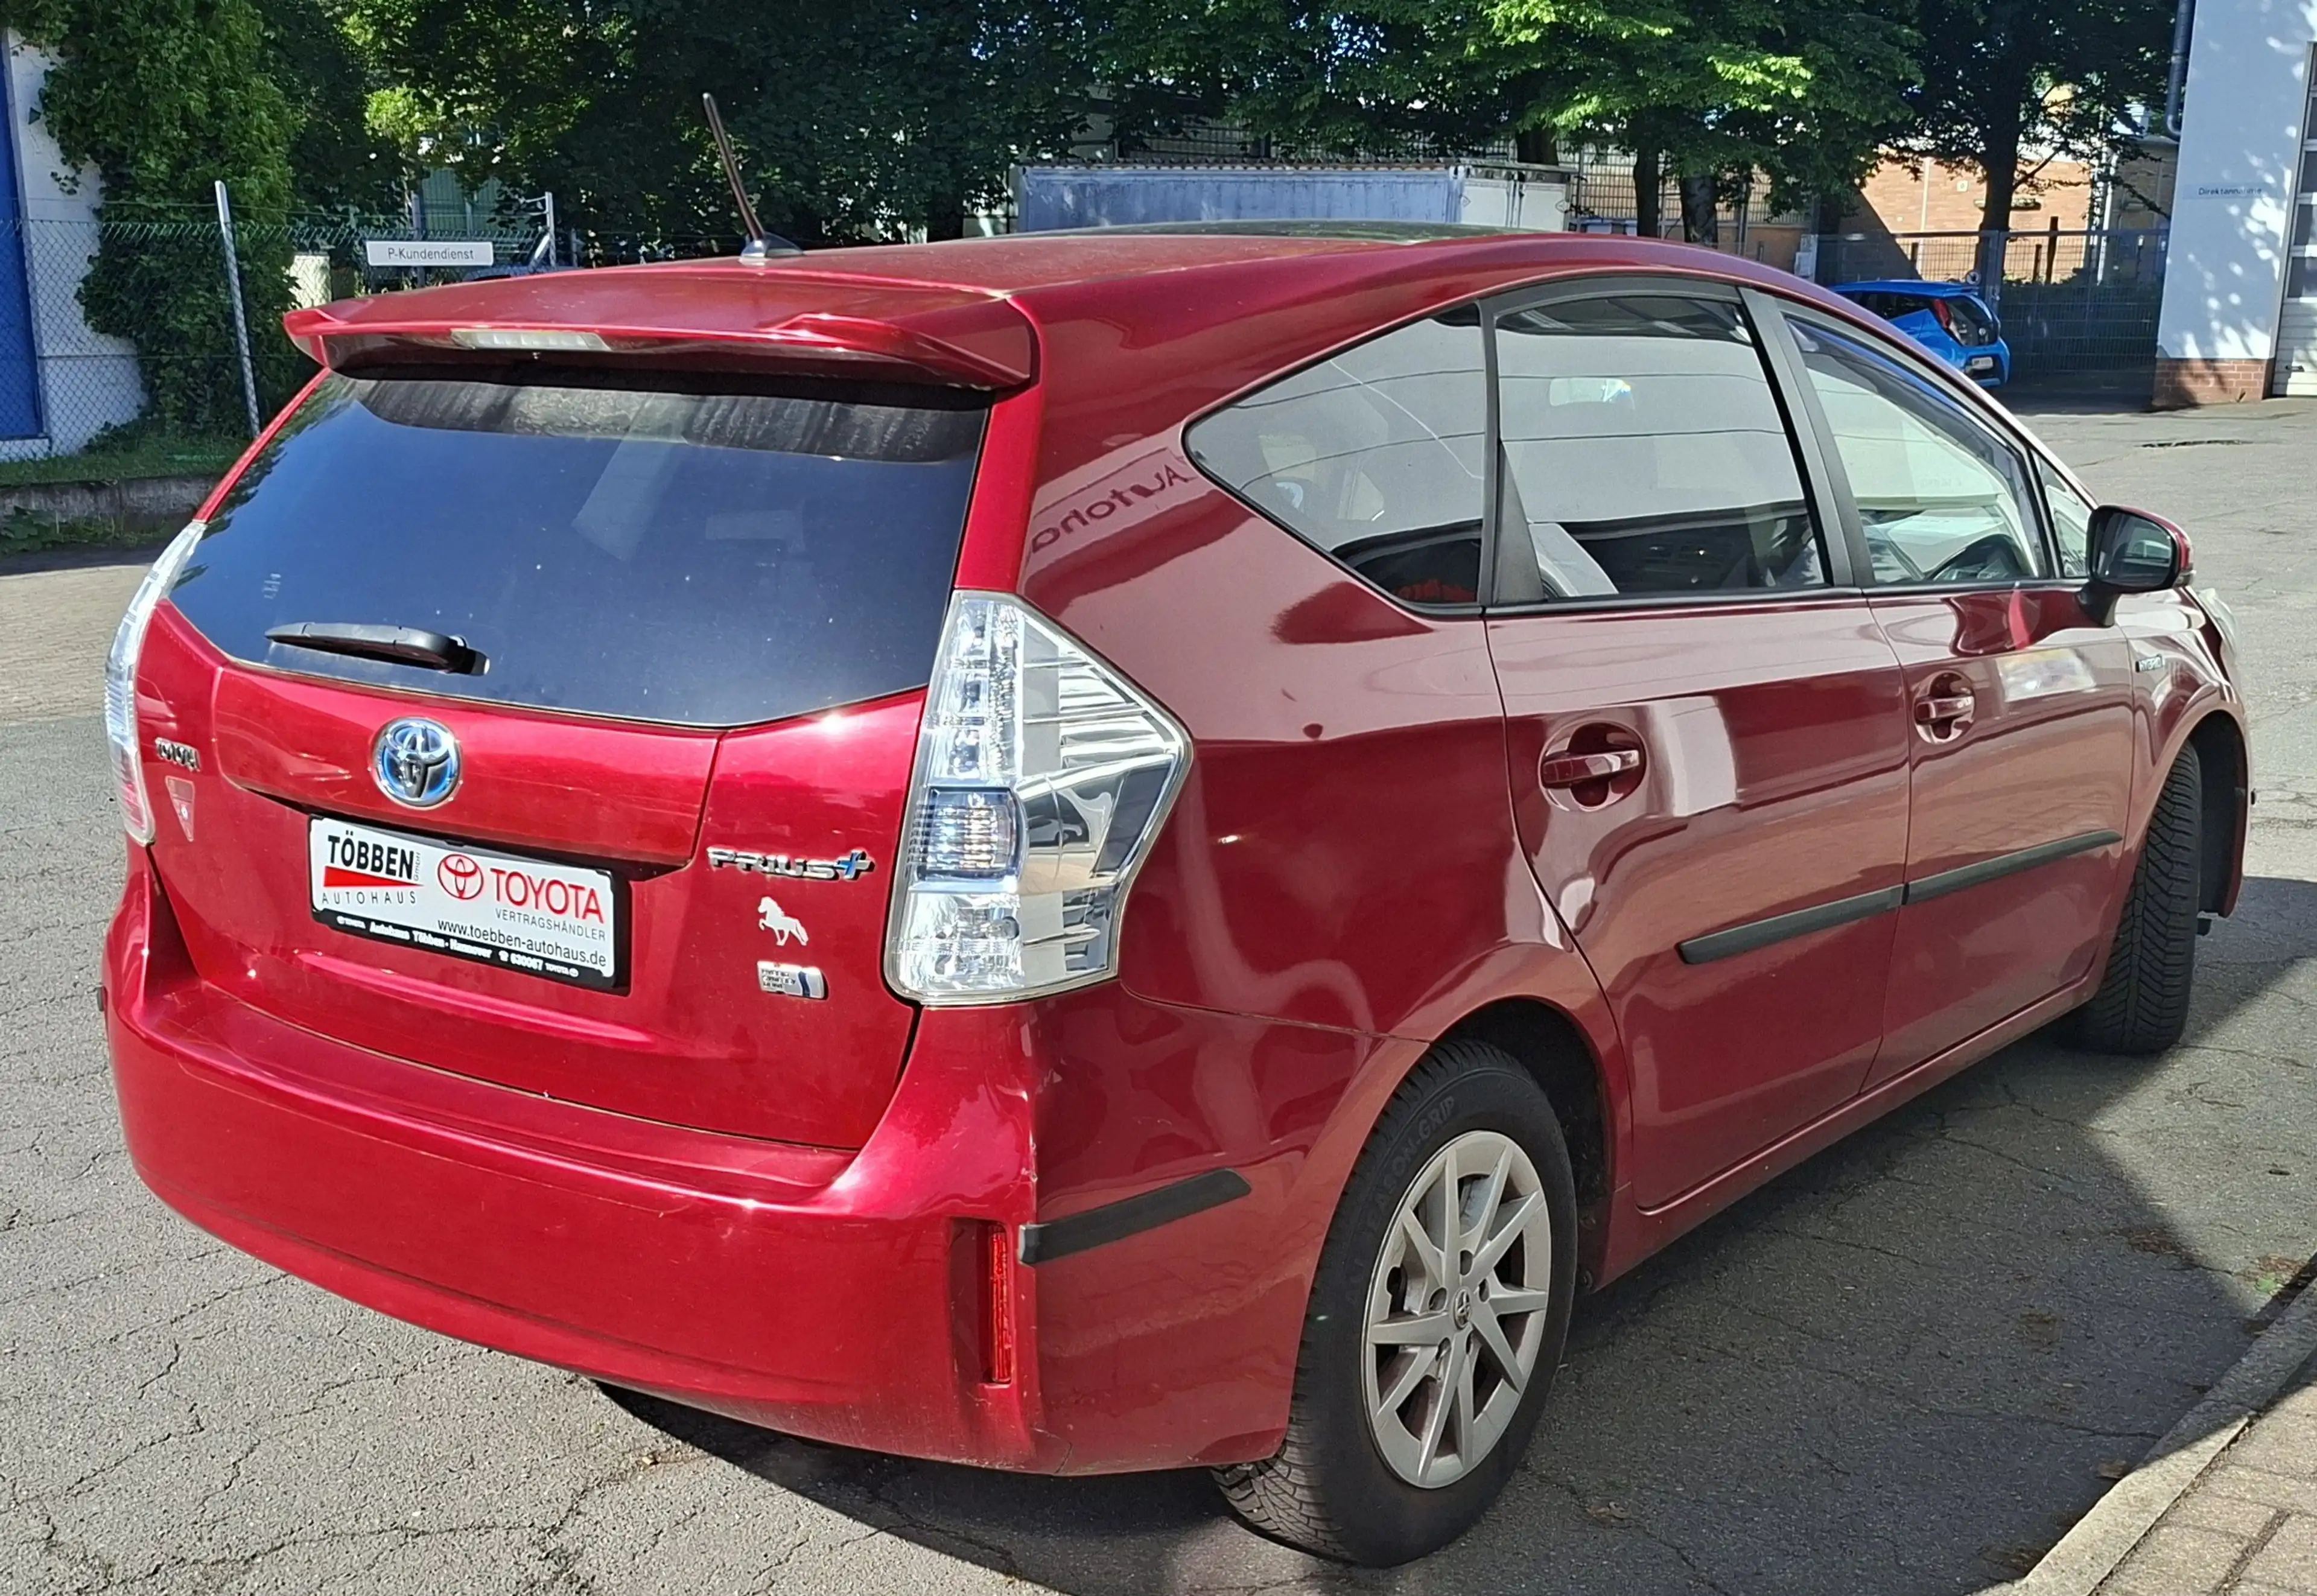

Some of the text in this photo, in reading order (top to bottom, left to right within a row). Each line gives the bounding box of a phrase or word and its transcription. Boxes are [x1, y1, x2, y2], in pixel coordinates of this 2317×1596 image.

[388, 247, 474, 259] P-Kundendienst
[328, 830, 415, 880] TÖBBEN
[321, 891, 416, 905] AUTOHAUS
[490, 868, 604, 923] TOYOTA
[437, 920, 606, 967] www.toebben-autohaus.de
